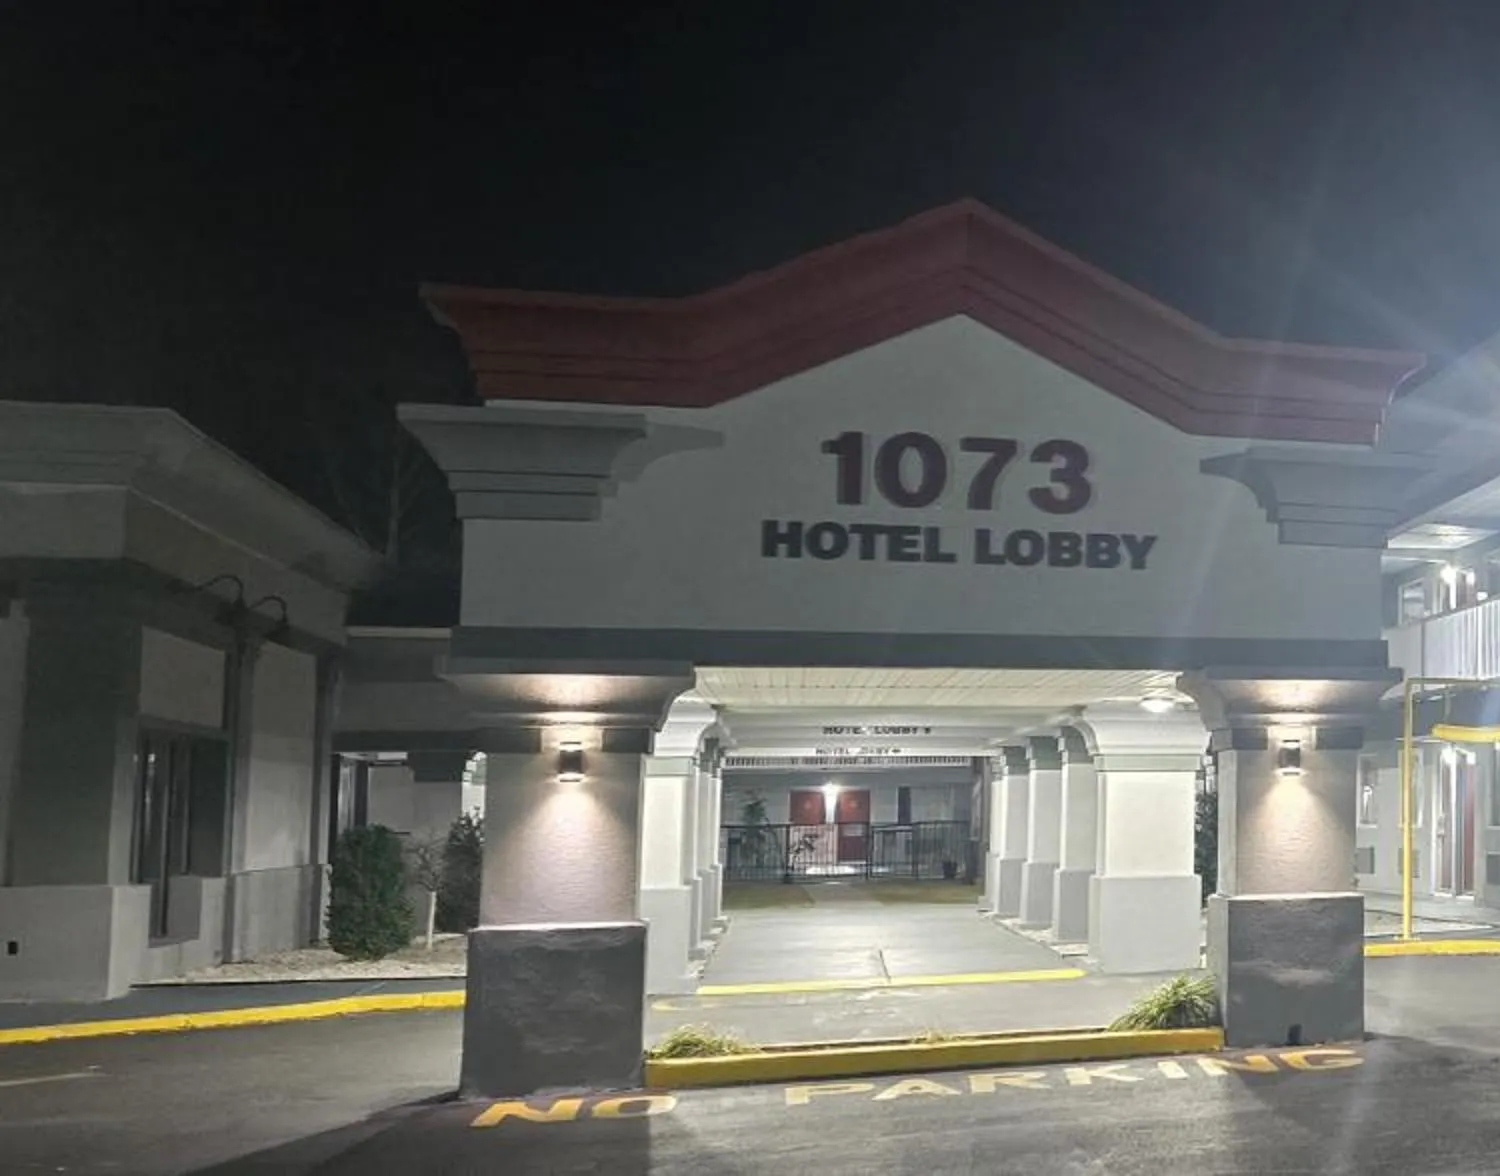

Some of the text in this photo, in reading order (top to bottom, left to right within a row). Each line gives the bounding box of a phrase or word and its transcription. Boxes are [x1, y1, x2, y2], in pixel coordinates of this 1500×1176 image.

[820, 431, 1092, 515] 1073
[761, 520, 1158, 569] HOTEL LOBBY
[470, 1048, 1365, 1127] NO PARKING
